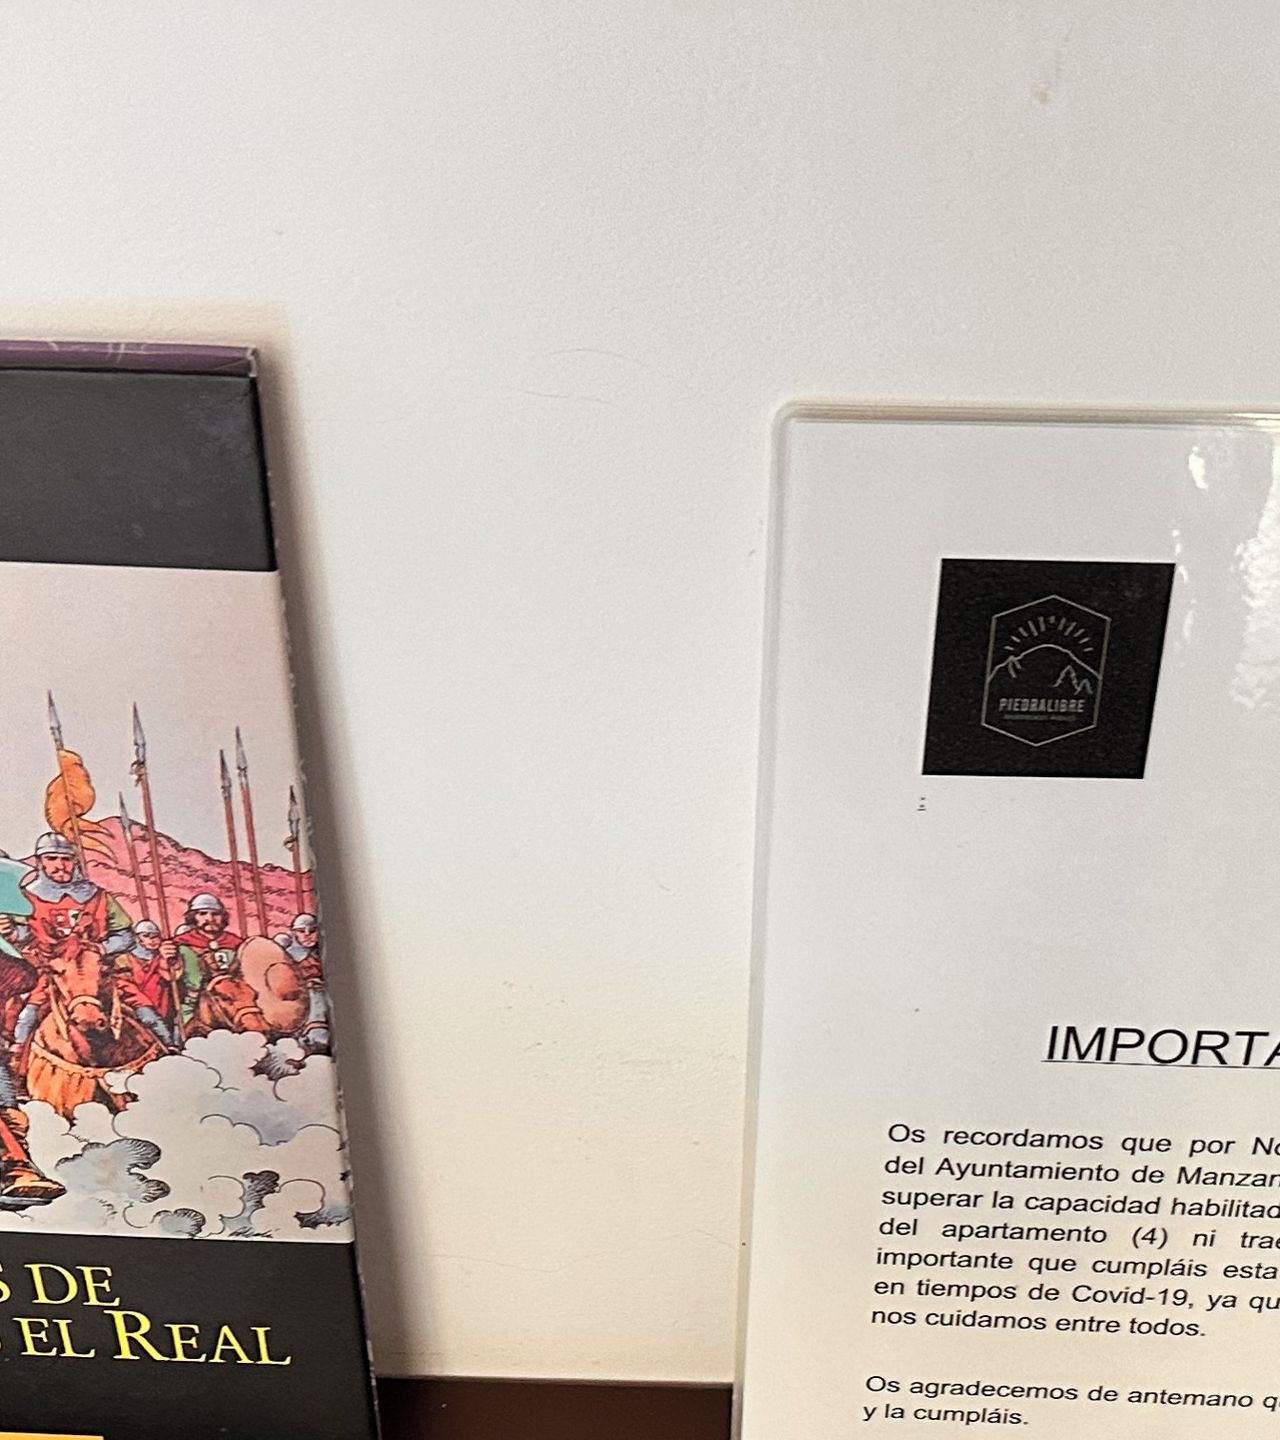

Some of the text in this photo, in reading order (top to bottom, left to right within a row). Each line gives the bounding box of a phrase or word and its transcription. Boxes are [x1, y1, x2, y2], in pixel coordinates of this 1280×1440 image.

[998, 698, 1085, 713] PIEDRALIBRE
[887, 1123, 926, 1144] Os
[942, 1128, 1104, 1151] recordamos
[1121, 1134, 1172, 1154] que
[1189, 1138, 1236, 1158] por
[884, 1155, 925, 1176] del
[935, 1157, 1120, 1184] Ayuntamiento
[1131, 1165, 1165, 1185] de
[881, 1189, 984, 1210] superar
[991, 1190, 1015, 1209] la
[1023, 1194, 1161, 1216] capacidad
[878, 1217, 919, 1237] del
[941, 1221, 1108, 1244] apartamento
[1131, 1227, 1169, 1250] (4)
[1192, 1229, 1217, 1248] ni
[875, 1248, 1014, 1272] importante
[1027, 1256, 1077, 1275] que
[1091, 1256, 1209, 1280] cumpláis
[1222, 1261, 1279, 1281] esta
[23, 1262, 121, 1308] DE
[873, 1279, 905, 1296] en
[916, 1278, 1018, 1303] tiempos
[1028, 1284, 1061, 1301] de
[1071, 1285, 1195, 1310] Covid-19,
[1205, 1292, 1238, 1312] ya
[13, 1317, 97, 1360] EL
[111, 1308, 292, 1367] REAL
[871, 1309, 1207, 1338] nos cuidamos entre todos.
[866, 1375, 901, 1395] Os
[909, 1379, 1079, 1403] agradecemos
[1087, 1385, 1119, 1403] de
[1127, 1388, 1254, 1409] antemano
[862, 1403, 1030, 1426] y la cumpláis.
